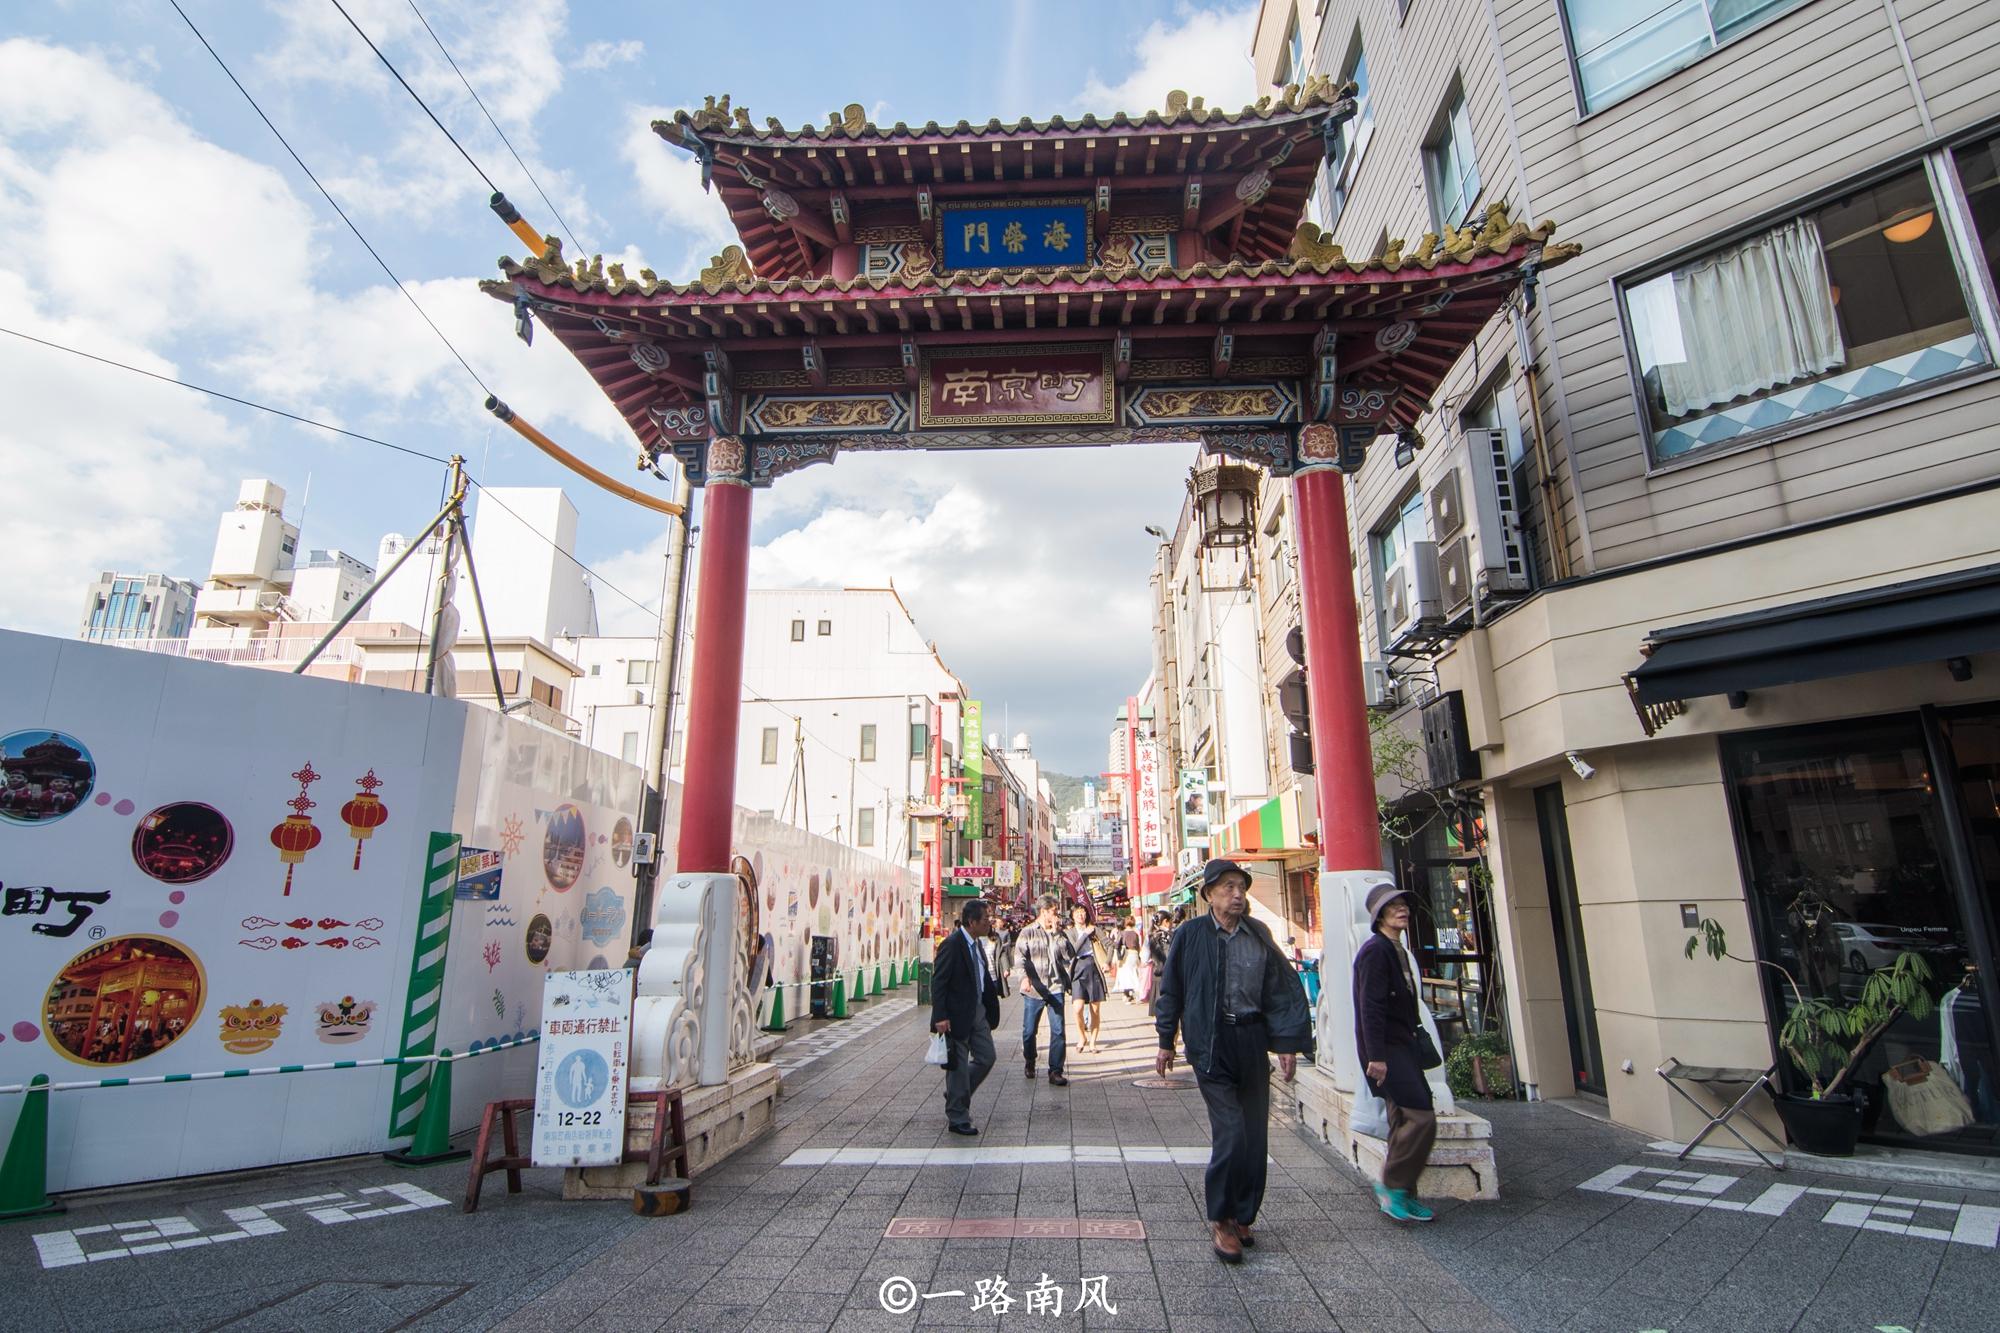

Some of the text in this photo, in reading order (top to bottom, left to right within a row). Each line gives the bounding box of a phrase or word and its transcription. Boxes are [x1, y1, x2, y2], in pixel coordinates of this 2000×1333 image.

[941, 368, 1092, 407] 南京町
[549, 1016, 622, 1036] 車両通行禁止
[558, 1111, 602, 1127] 12-22
